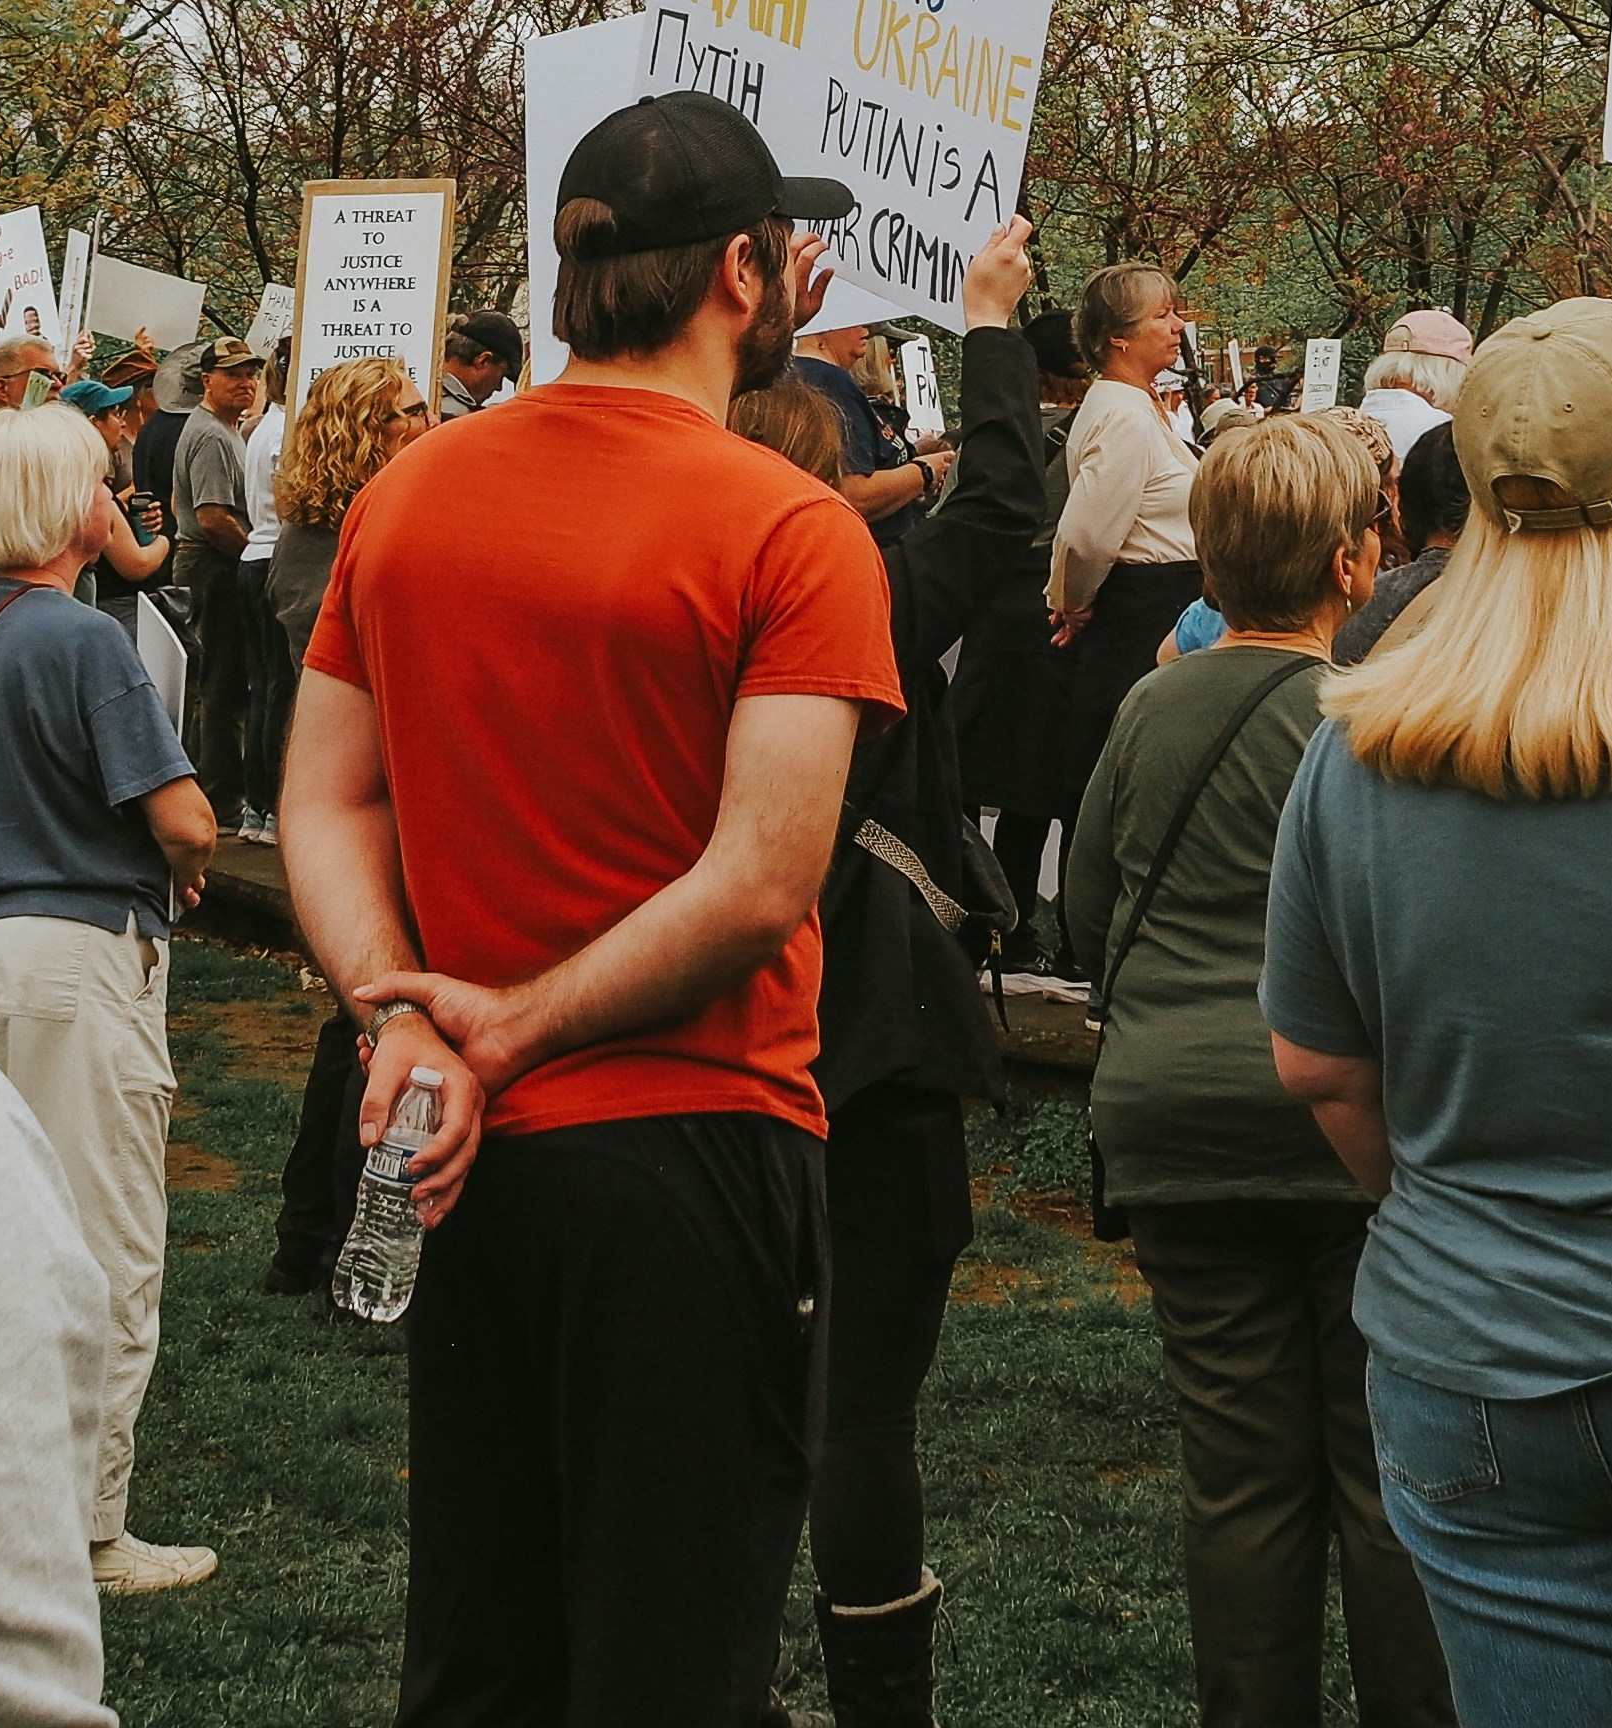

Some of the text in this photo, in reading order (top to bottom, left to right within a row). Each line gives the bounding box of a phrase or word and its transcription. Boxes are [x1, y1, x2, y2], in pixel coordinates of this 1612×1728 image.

[820, 77, 925, 190] PUTIN
[964, 149, 1002, 224] A
[334, 209, 417, 224] A THREAT
[362, 232, 385, 245] TO
[340, 255, 403, 269] JUSTICE
[14, 266, 44, 291] BAD!
[324, 276, 417, 292] ANYWHERE
[353, 299, 381, 313] IS A
[321, 322, 413, 337] THREAT TO
[333, 344, 396, 359] JUSTICE
